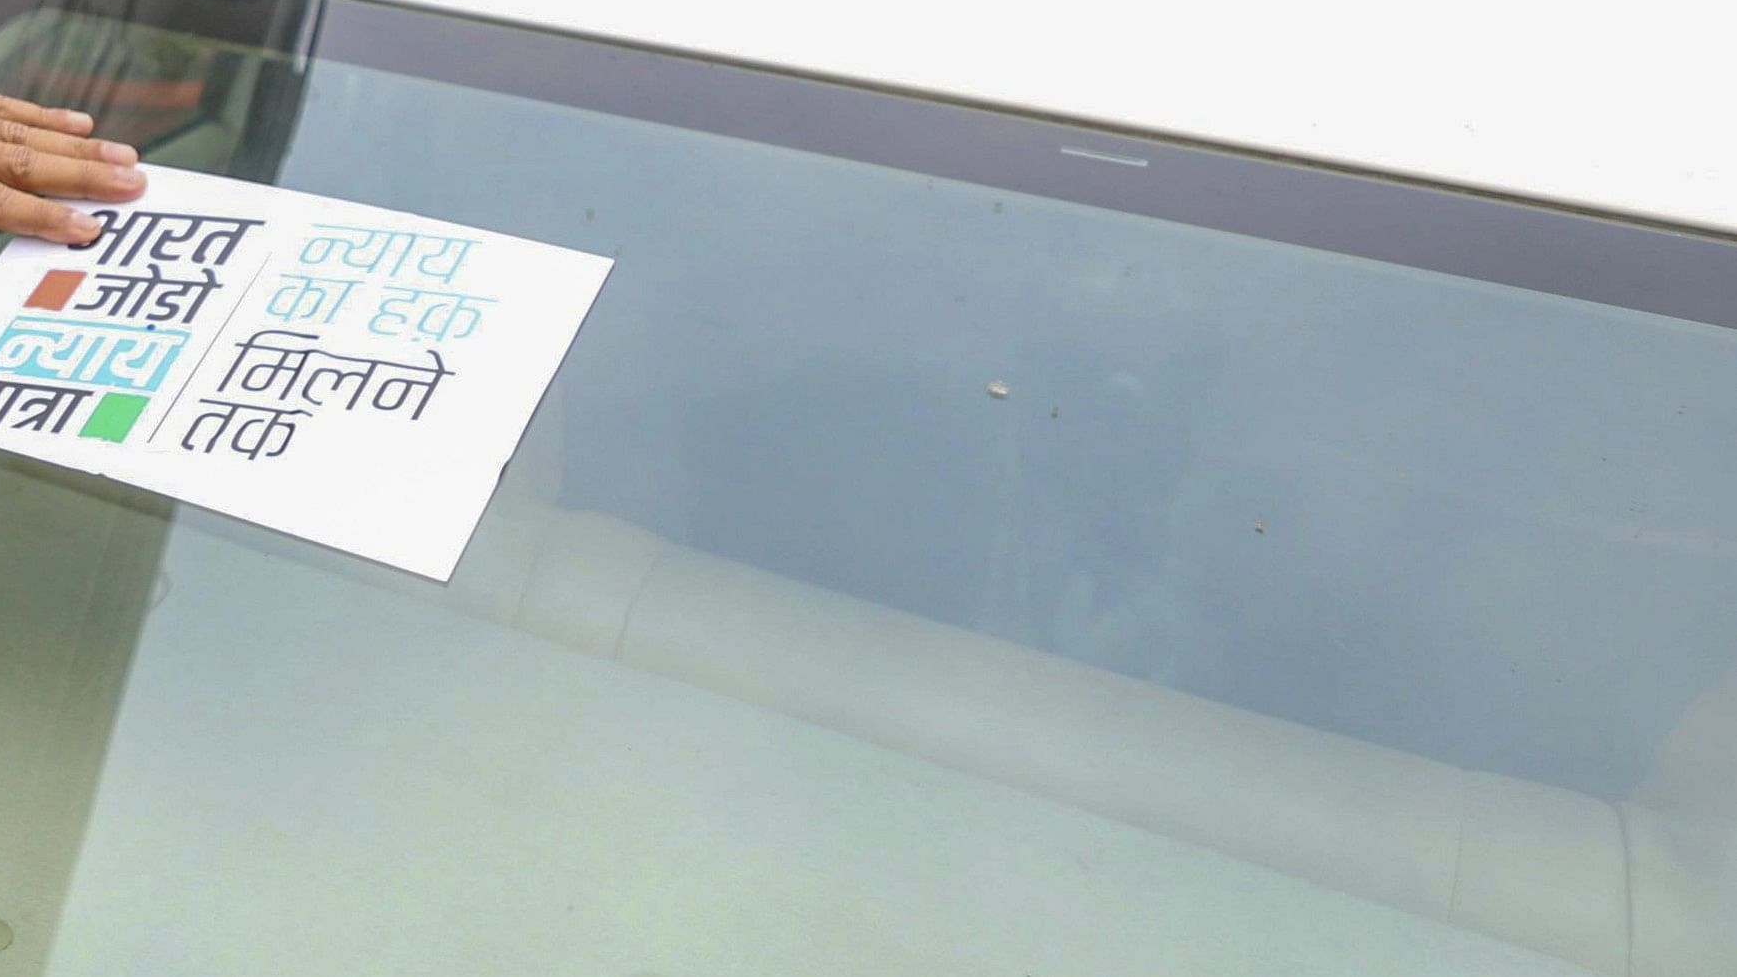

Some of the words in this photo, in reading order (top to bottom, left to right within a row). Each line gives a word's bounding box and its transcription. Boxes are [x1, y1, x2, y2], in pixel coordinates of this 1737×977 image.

[67, 209, 266, 267] भारत
[299, 223, 483, 284] न्याय
[266, 273, 365, 323] का
[216, 330, 456, 420] मिलने
[180, 399, 313, 460] तक
